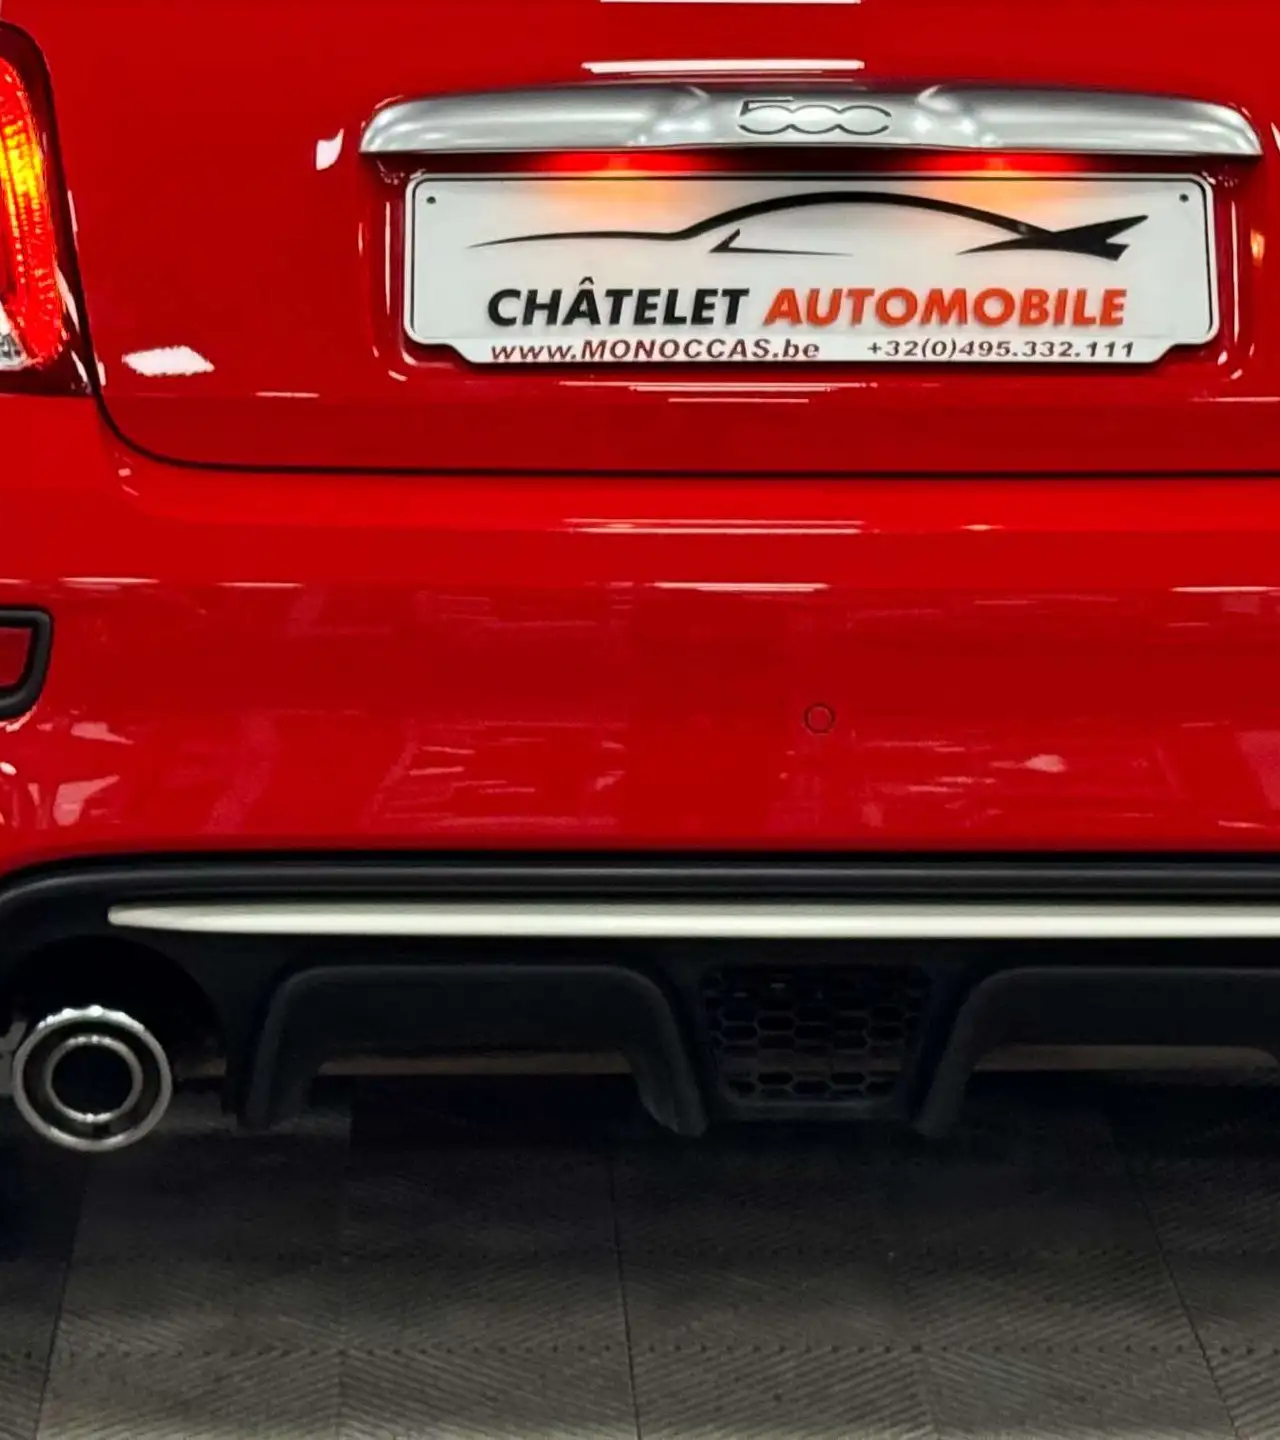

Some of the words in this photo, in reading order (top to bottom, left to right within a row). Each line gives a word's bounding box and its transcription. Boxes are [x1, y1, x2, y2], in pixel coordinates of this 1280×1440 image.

[487, 276, 750, 327] CHÂTELET
[762, 287, 1127, 327] AUTOMOBILE
[490, 338, 820, 361] www.MONOCCAS.be
[867, 339, 1135, 361] +32(0)495.332.111
